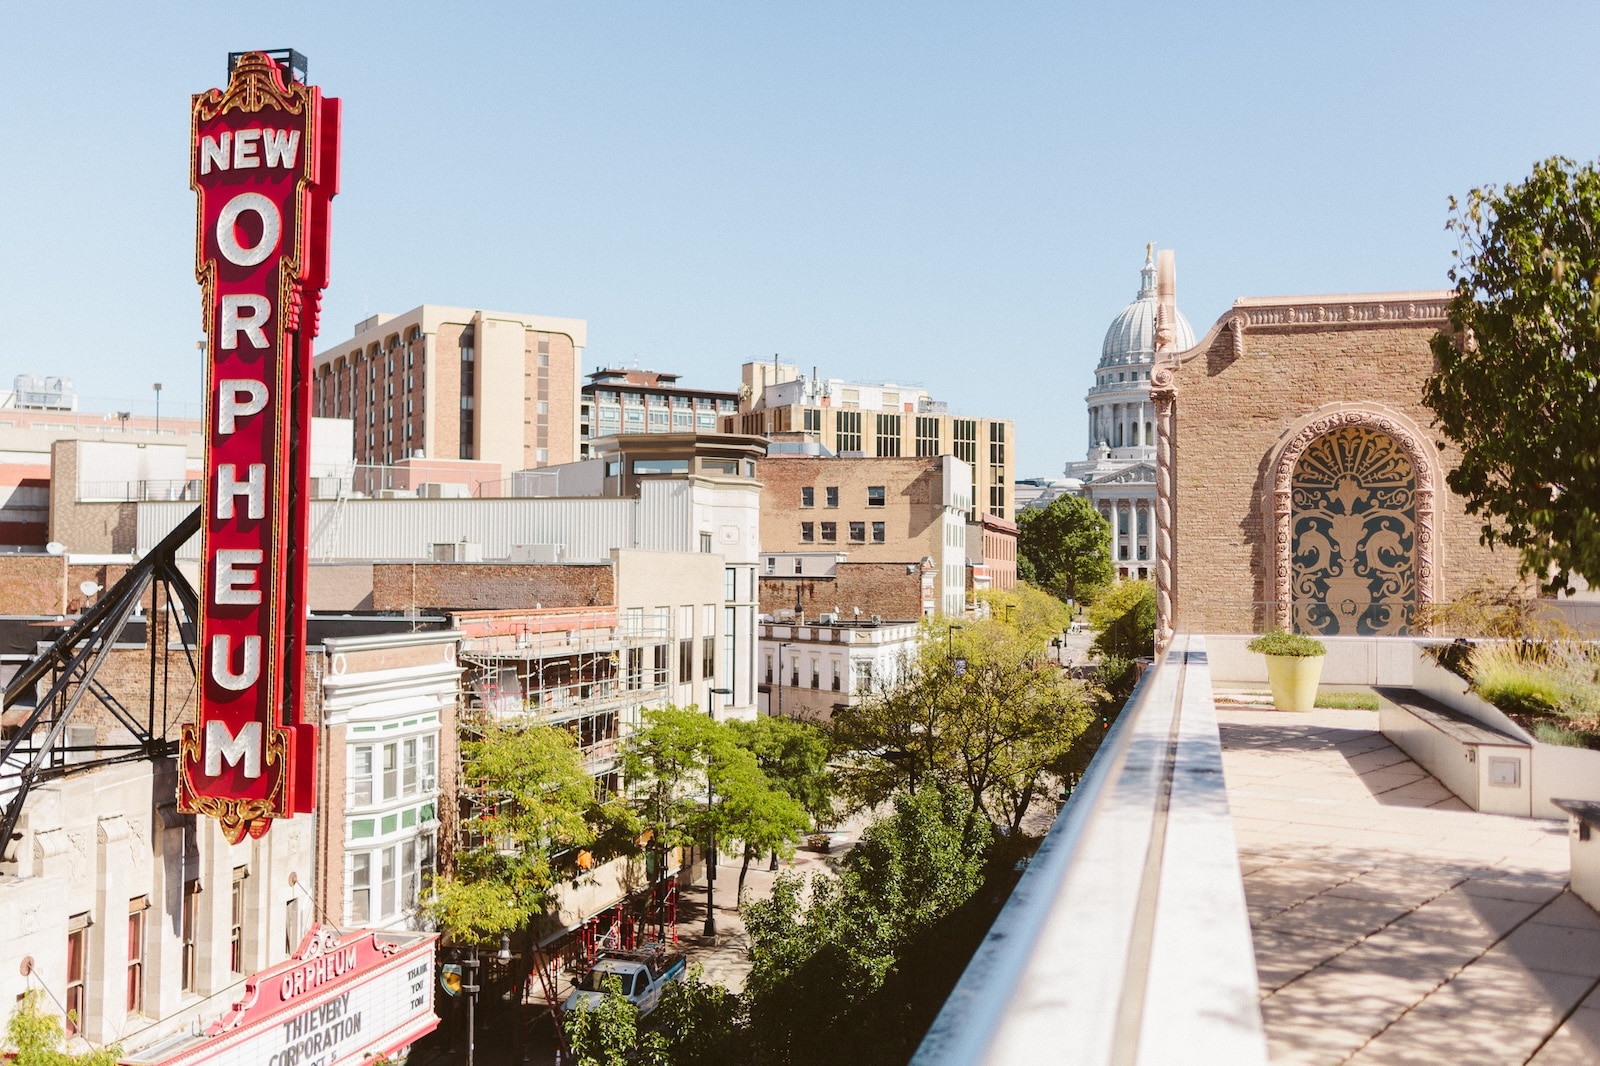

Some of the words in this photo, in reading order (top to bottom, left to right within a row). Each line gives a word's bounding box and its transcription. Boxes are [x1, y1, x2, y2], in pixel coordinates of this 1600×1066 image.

[201, 129, 301, 176] NEW
[205, 192, 282, 779] ORPHEUM
[280, 946, 357, 1001] ORPHEUM
[407, 963, 427, 981] THANK
[411, 980, 424, 994] YOU
[269, 1011, 361, 1066] CORPORATION
[283, 992, 350, 1044] THIEVERY
